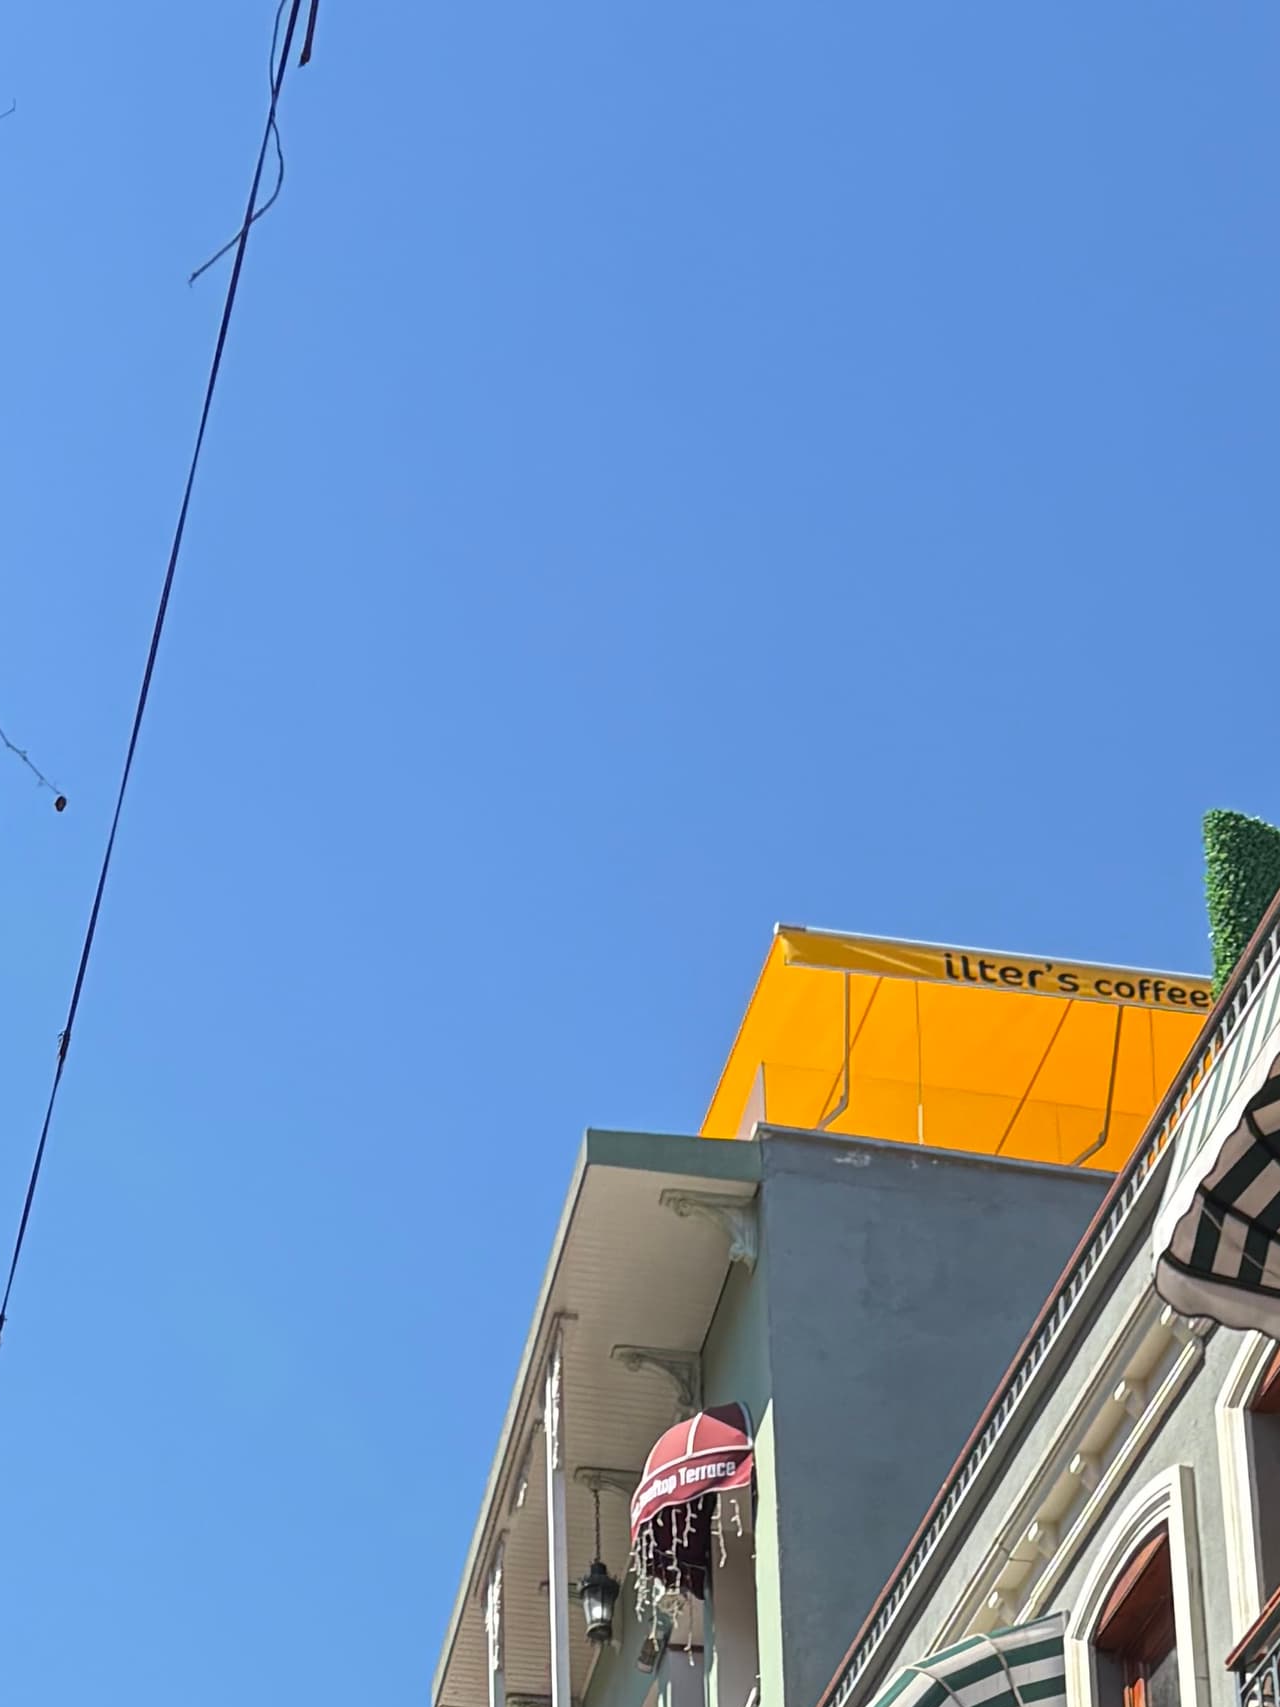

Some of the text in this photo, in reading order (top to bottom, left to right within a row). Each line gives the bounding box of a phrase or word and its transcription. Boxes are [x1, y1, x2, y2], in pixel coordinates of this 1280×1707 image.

[943, 952, 1210, 1008] ilter's coffee
[678, 1461, 736, 1487] Terrace
